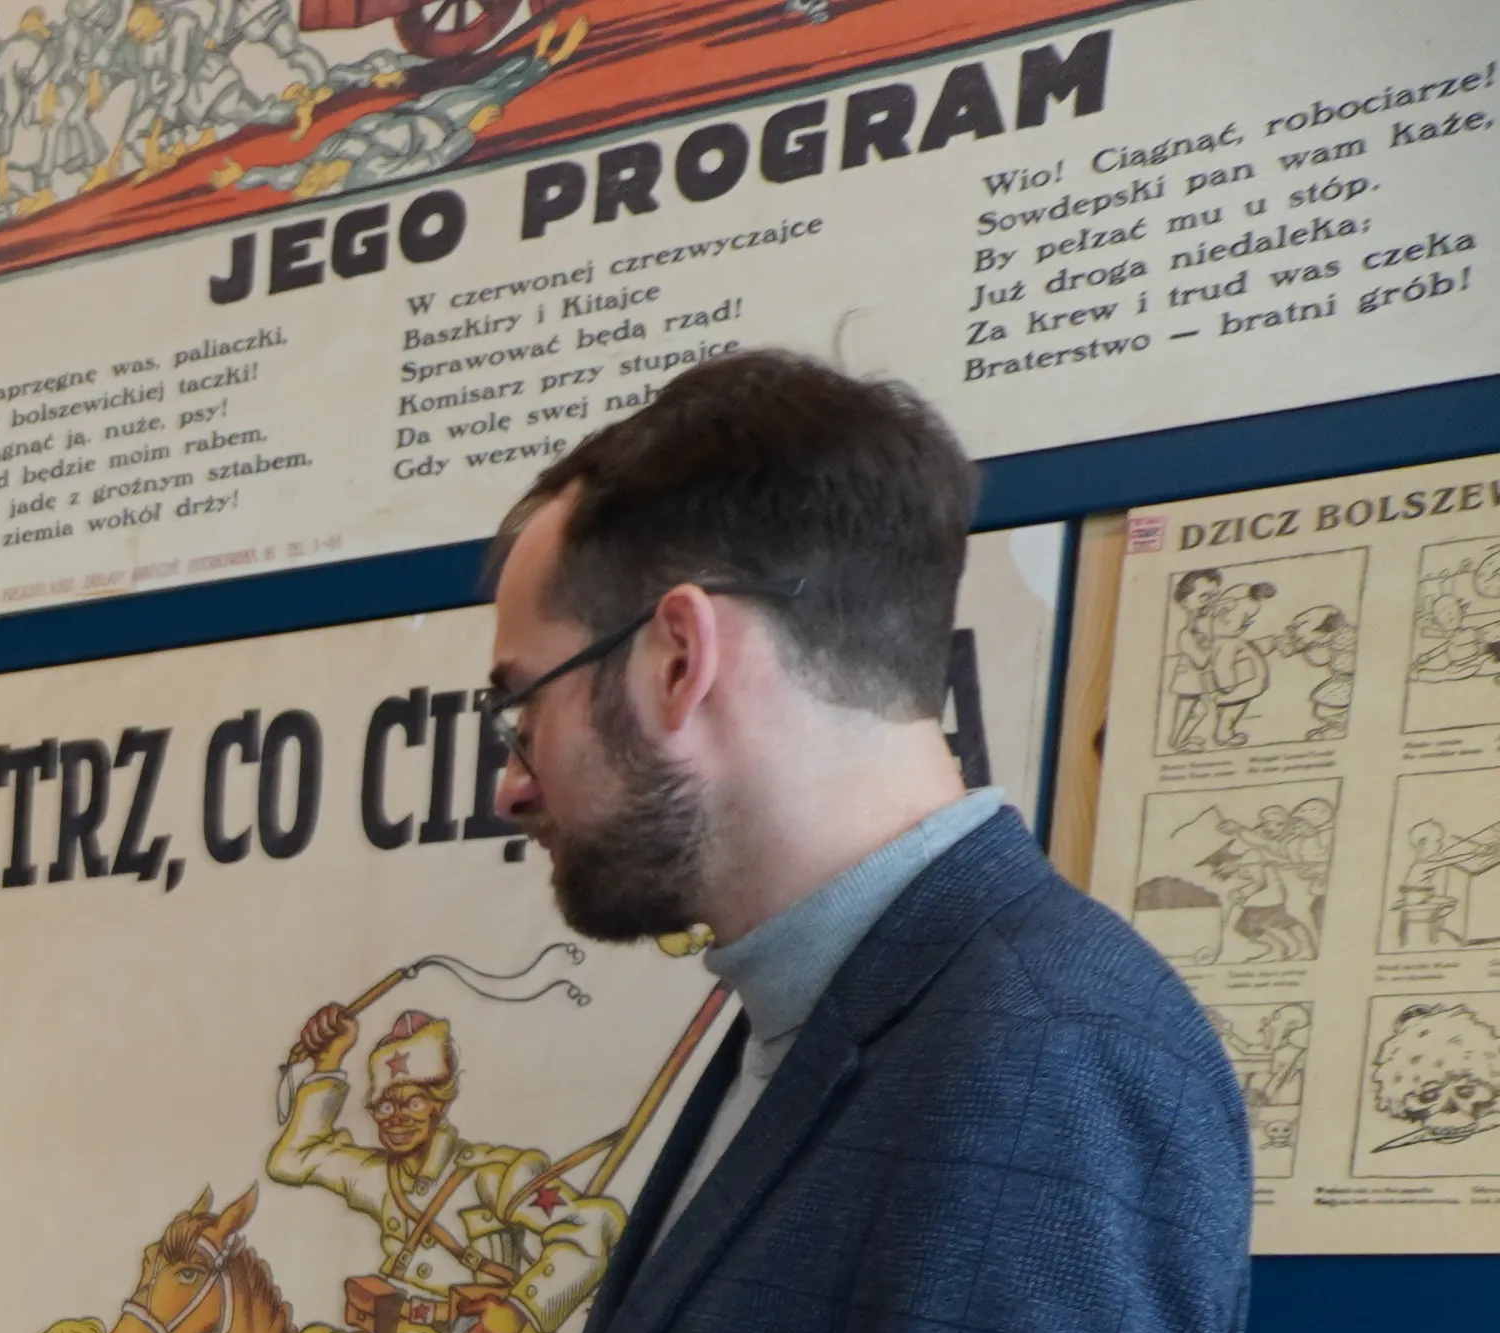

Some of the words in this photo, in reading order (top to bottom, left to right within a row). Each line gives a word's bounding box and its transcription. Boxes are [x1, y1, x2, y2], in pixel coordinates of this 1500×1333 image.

[209, 190, 468, 306] JEGO
[520, 28, 1113, 241] PROGRAM
[984, 160, 1064, 197] Wio!
[1265, 61, 1497, 138] robociarze!
[977, 175, 1166, 236] Sowdepski
[1186, 162, 1256, 196] pan
[1279, 137, 1368, 172] wam
[1389, 110, 1495, 149] każe,
[973, 248, 1017, 273] By
[1035, 217, 1148, 264] pełzać
[1166, 206, 1223, 234] mu
[1245, 197, 1267, 217] u
[1289, 176, 1381, 210] stóp.
[406, 293, 436, 316] W
[449, 260, 596, 310] czerwonej
[609, 215, 824, 276] czrezwyczajce
[966, 321, 1009, 346] Za
[1027, 302, 1119, 335] krew
[1137, 291, 1149, 315] i
[1168, 270, 1248, 308] trud
[1270, 259, 1341, 288] was
[1363, 231, 1478, 271] czeka
[969, 280, 1026, 312] Już
[1045, 258, 1149, 294] droga
[1170, 216, 1372, 271] niedaleka;
[400, 337, 560, 383] Sprawować
[577, 320, 647, 350] będą
[664, 298, 744, 333] rząd!
[402, 311, 520, 351] Baszkiry
[537, 309, 545, 324] i
[561, 283, 661, 319] Kitajce
[963, 332, 1151, 383] Braterstwo
[1219, 293, 1338, 336] bratni
[1356, 265, 1472, 315] grób!
[11, 381, 165, 429] bolszewickiej
[179, 361, 260, 396] taczki!
[179, 397, 229, 429] psy!
[395, 426, 431, 449] Da
[447, 411, 511, 441] wolę
[527, 398, 589, 427] swej
[398, 380, 525, 416] Komisarz
[541, 363, 603, 393] przy
[9, 492, 57, 521] jadę
[69, 492, 80, 507] z
[207, 451, 314, 482] sztabem,
[22, 456, 97, 486] będzie
[108, 443, 171, 469] moim
[184, 426, 268, 455] rabem,
[393, 454, 449, 480] Gdy
[2, 520, 74, 548] ziemia
[88, 503, 161, 533] wokół
[176, 489, 239, 518] drży!
[1179, 508, 1301, 552] DZICZ
[1313, 480, 1500, 533] BOLSZE
[203, 707, 323, 865] CO
